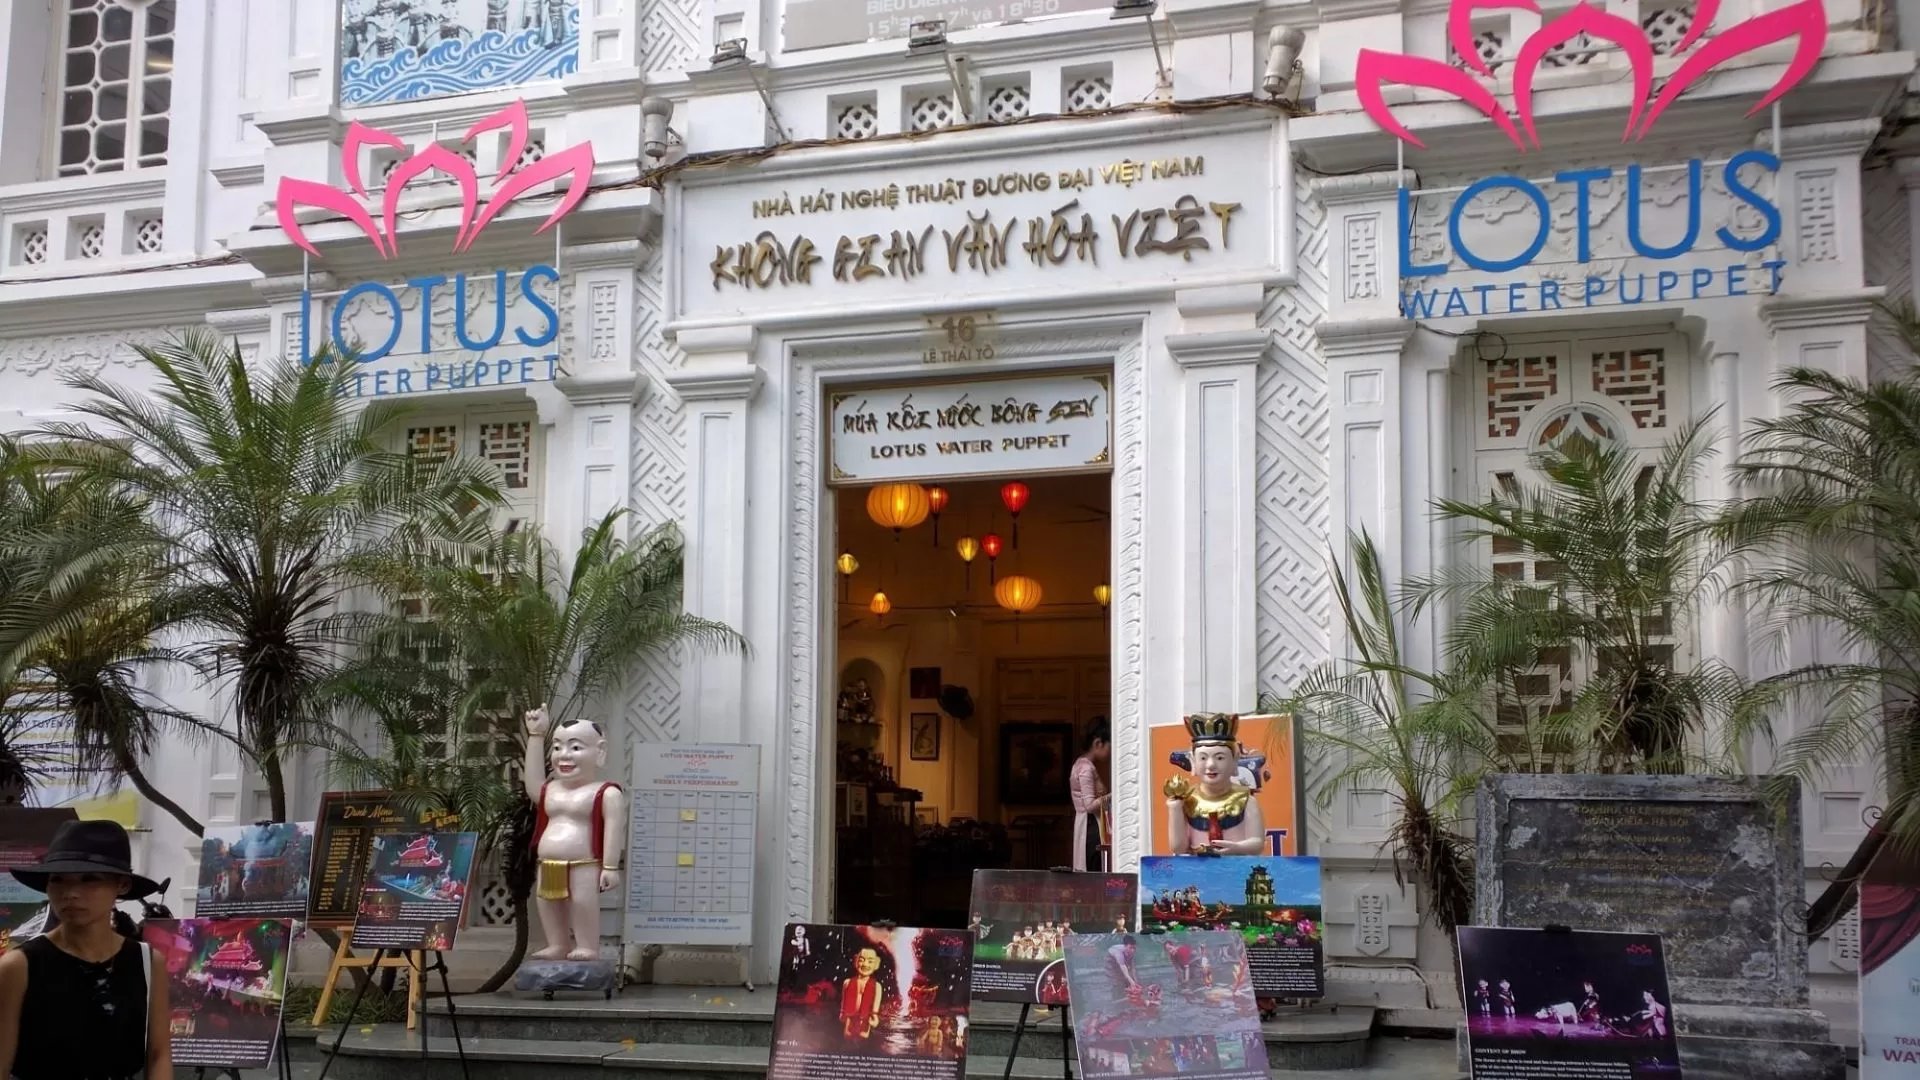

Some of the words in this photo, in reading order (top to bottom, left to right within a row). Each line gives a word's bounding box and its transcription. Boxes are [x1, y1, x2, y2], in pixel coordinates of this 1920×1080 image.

[753, 191, 794, 218] NHÀ
[800, 188, 834, 214] HÁT
[841, 183, 899, 210] NGHỆ
[906, 178, 966, 204] THUẬT
[972, 171, 1051, 197] ĐƯƠNG
[1058, 168, 1093, 192] ĐẠI
[1099, 158, 1146, 188] VIỆT
[1152, 156, 1204, 179] NAM
[1397, 150, 1782, 277] LOTUS
[710, 230, 823, 292] KHÔNG
[833, 224, 934, 282] GIAN
[943, 208, 1017, 276] VĂN
[1022, 198, 1099, 267] HÓA
[1111, 194, 1242, 262] VIỆT
[301, 264, 560, 367] LOTUS
[1400, 279, 1562, 321] WATER
[1585, 260, 1787, 307] PUPPET
[942, 315, 976, 344] 16
[425, 354, 560, 391] PUPPET
[843, 400, 878, 434] MÚA
[991, 397, 1043, 425] BÔNG
[1046, 395, 1099, 424] SEN
[870, 442, 927, 459] LOTUS
[936, 439, 993, 454] WATER
[1002, 434, 1071, 451] PUPPET
